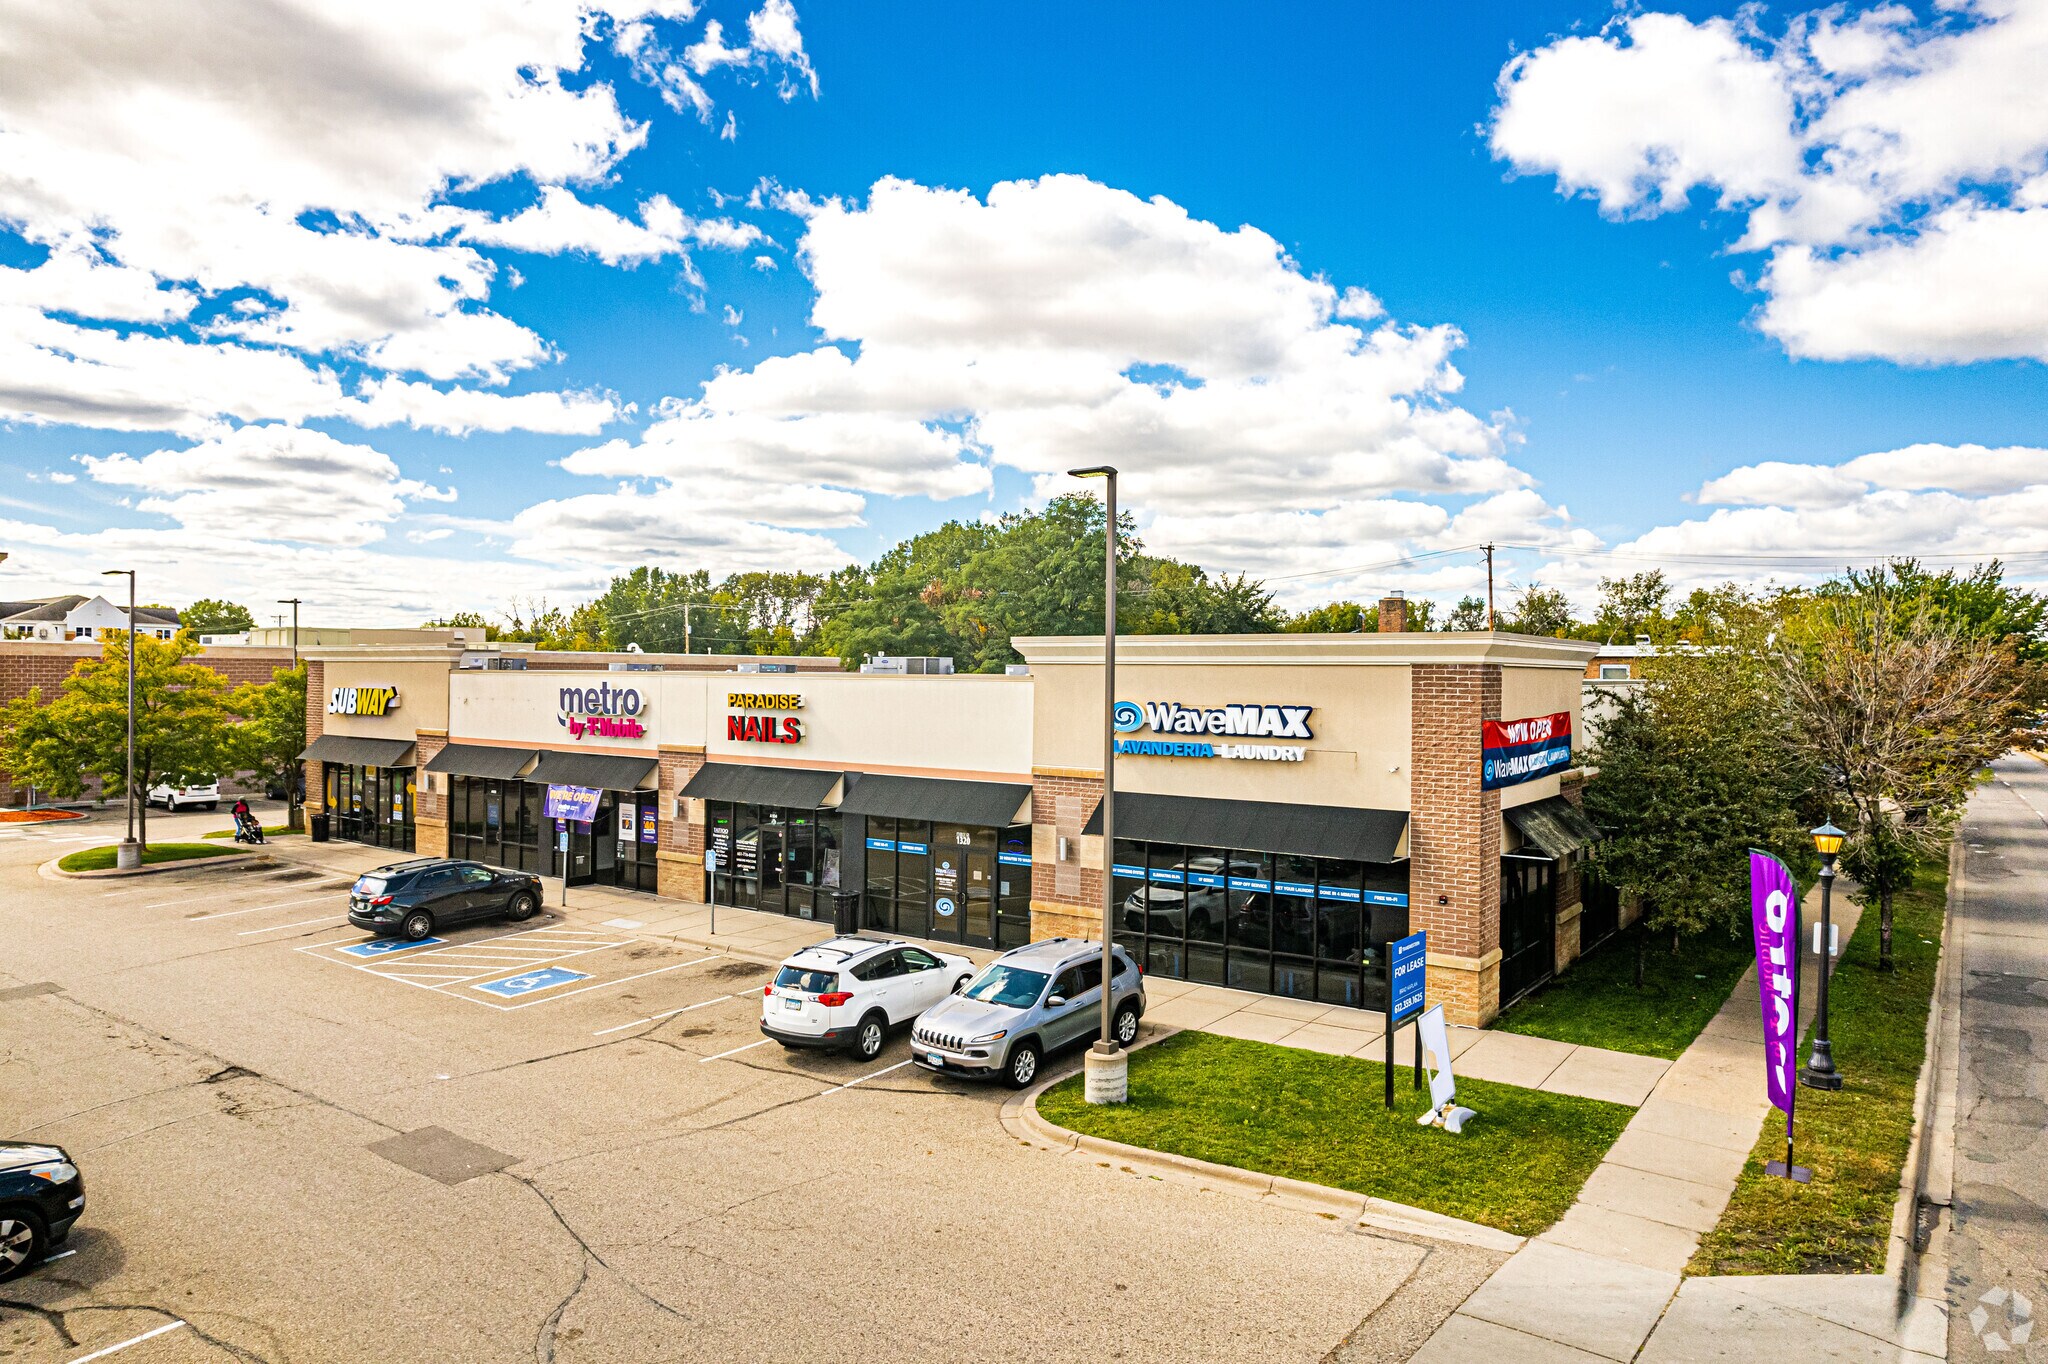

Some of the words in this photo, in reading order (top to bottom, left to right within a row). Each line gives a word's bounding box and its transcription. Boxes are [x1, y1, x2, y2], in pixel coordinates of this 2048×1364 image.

[327, 687, 395, 715] SUBWAY
[559, 682, 641, 716] metro
[728, 693, 799, 710] PARADISE
[570, 717, 585, 740] by
[728, 715, 800, 744] NAILS
[1147, 703, 1312, 738] WaveMAX
[1507, 722, 1529, 744] NOW
[1114, 740, 1213, 757] LAVANDERIA
[1221, 743, 1306, 761] LAUNDRY
[1494, 755, 1529, 779] WaveMAX
[550, 789, 572, 801] WE'RE
[573, 792, 596, 804] OPEN
[956, 836, 971, 845] 1320
[1394, 964, 1406, 978] FOR
[1406, 956, 1424, 973] LEASE
